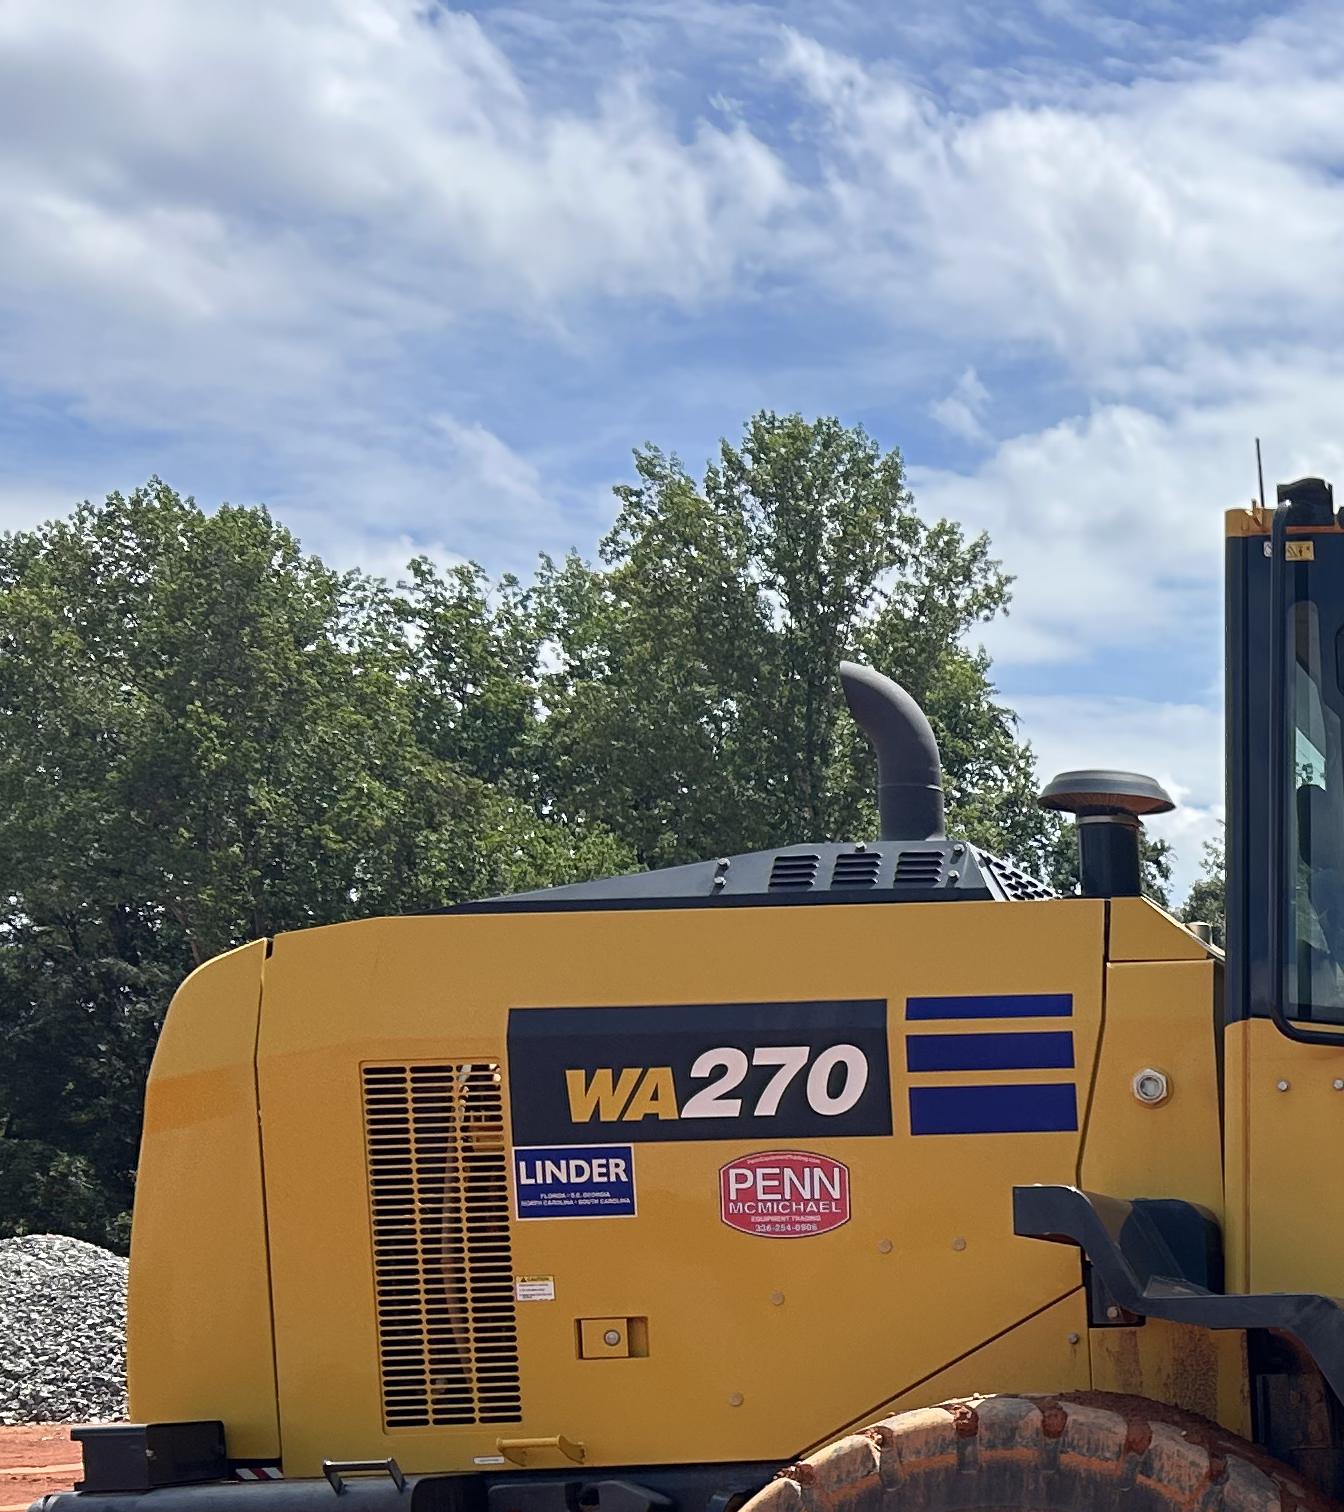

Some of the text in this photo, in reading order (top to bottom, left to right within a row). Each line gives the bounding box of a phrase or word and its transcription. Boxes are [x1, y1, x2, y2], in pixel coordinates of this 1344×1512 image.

[565, 1044, 869, 1123] WA270
[519, 1158, 629, 1185] LINDER
[728, 1167, 841, 1201] PENN
[729, 1201, 841, 1214] MCMICHAEL
